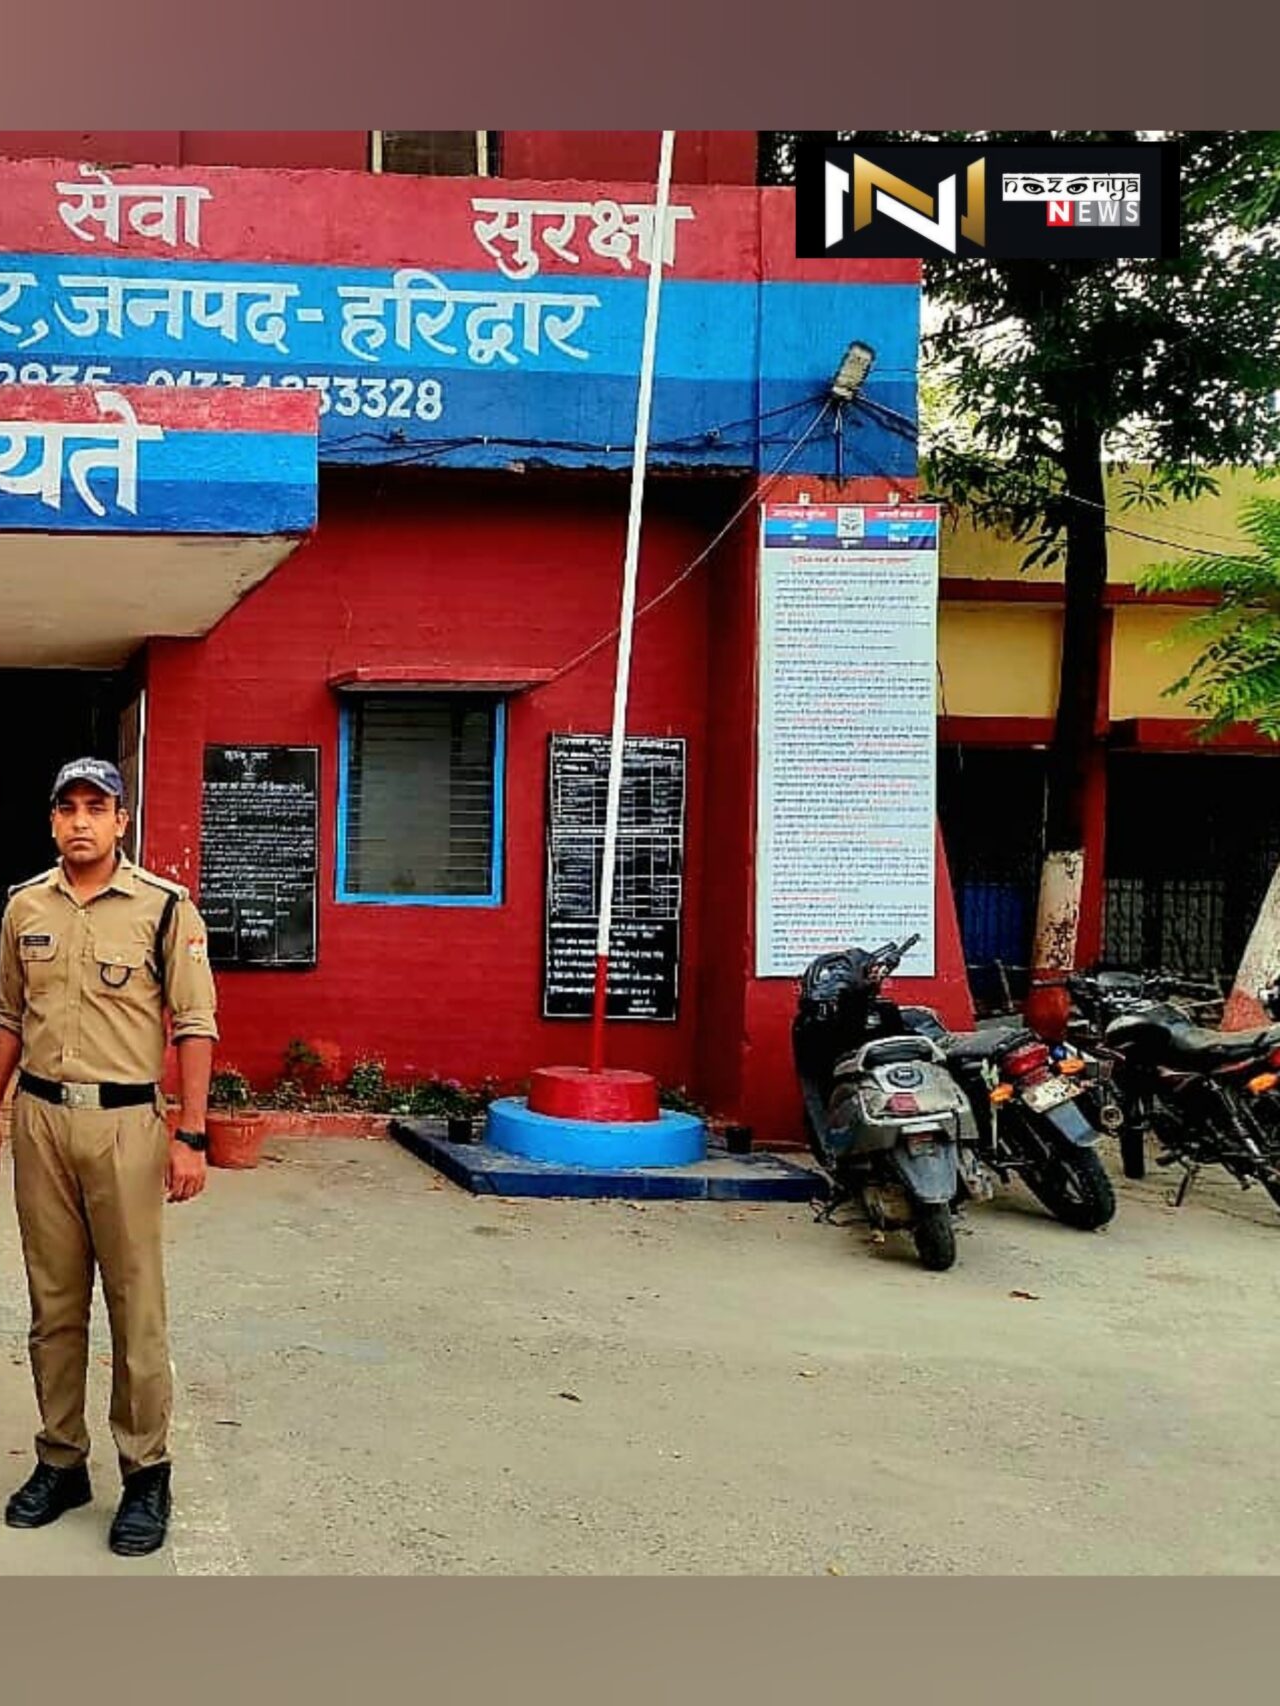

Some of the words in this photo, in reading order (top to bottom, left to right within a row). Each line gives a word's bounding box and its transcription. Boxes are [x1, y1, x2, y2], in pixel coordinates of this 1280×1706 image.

[56, 163, 213, 249] सेवा
[472, 197, 695, 279] सुरक्षा
[337, 267, 601, 364] हरिद्वार
